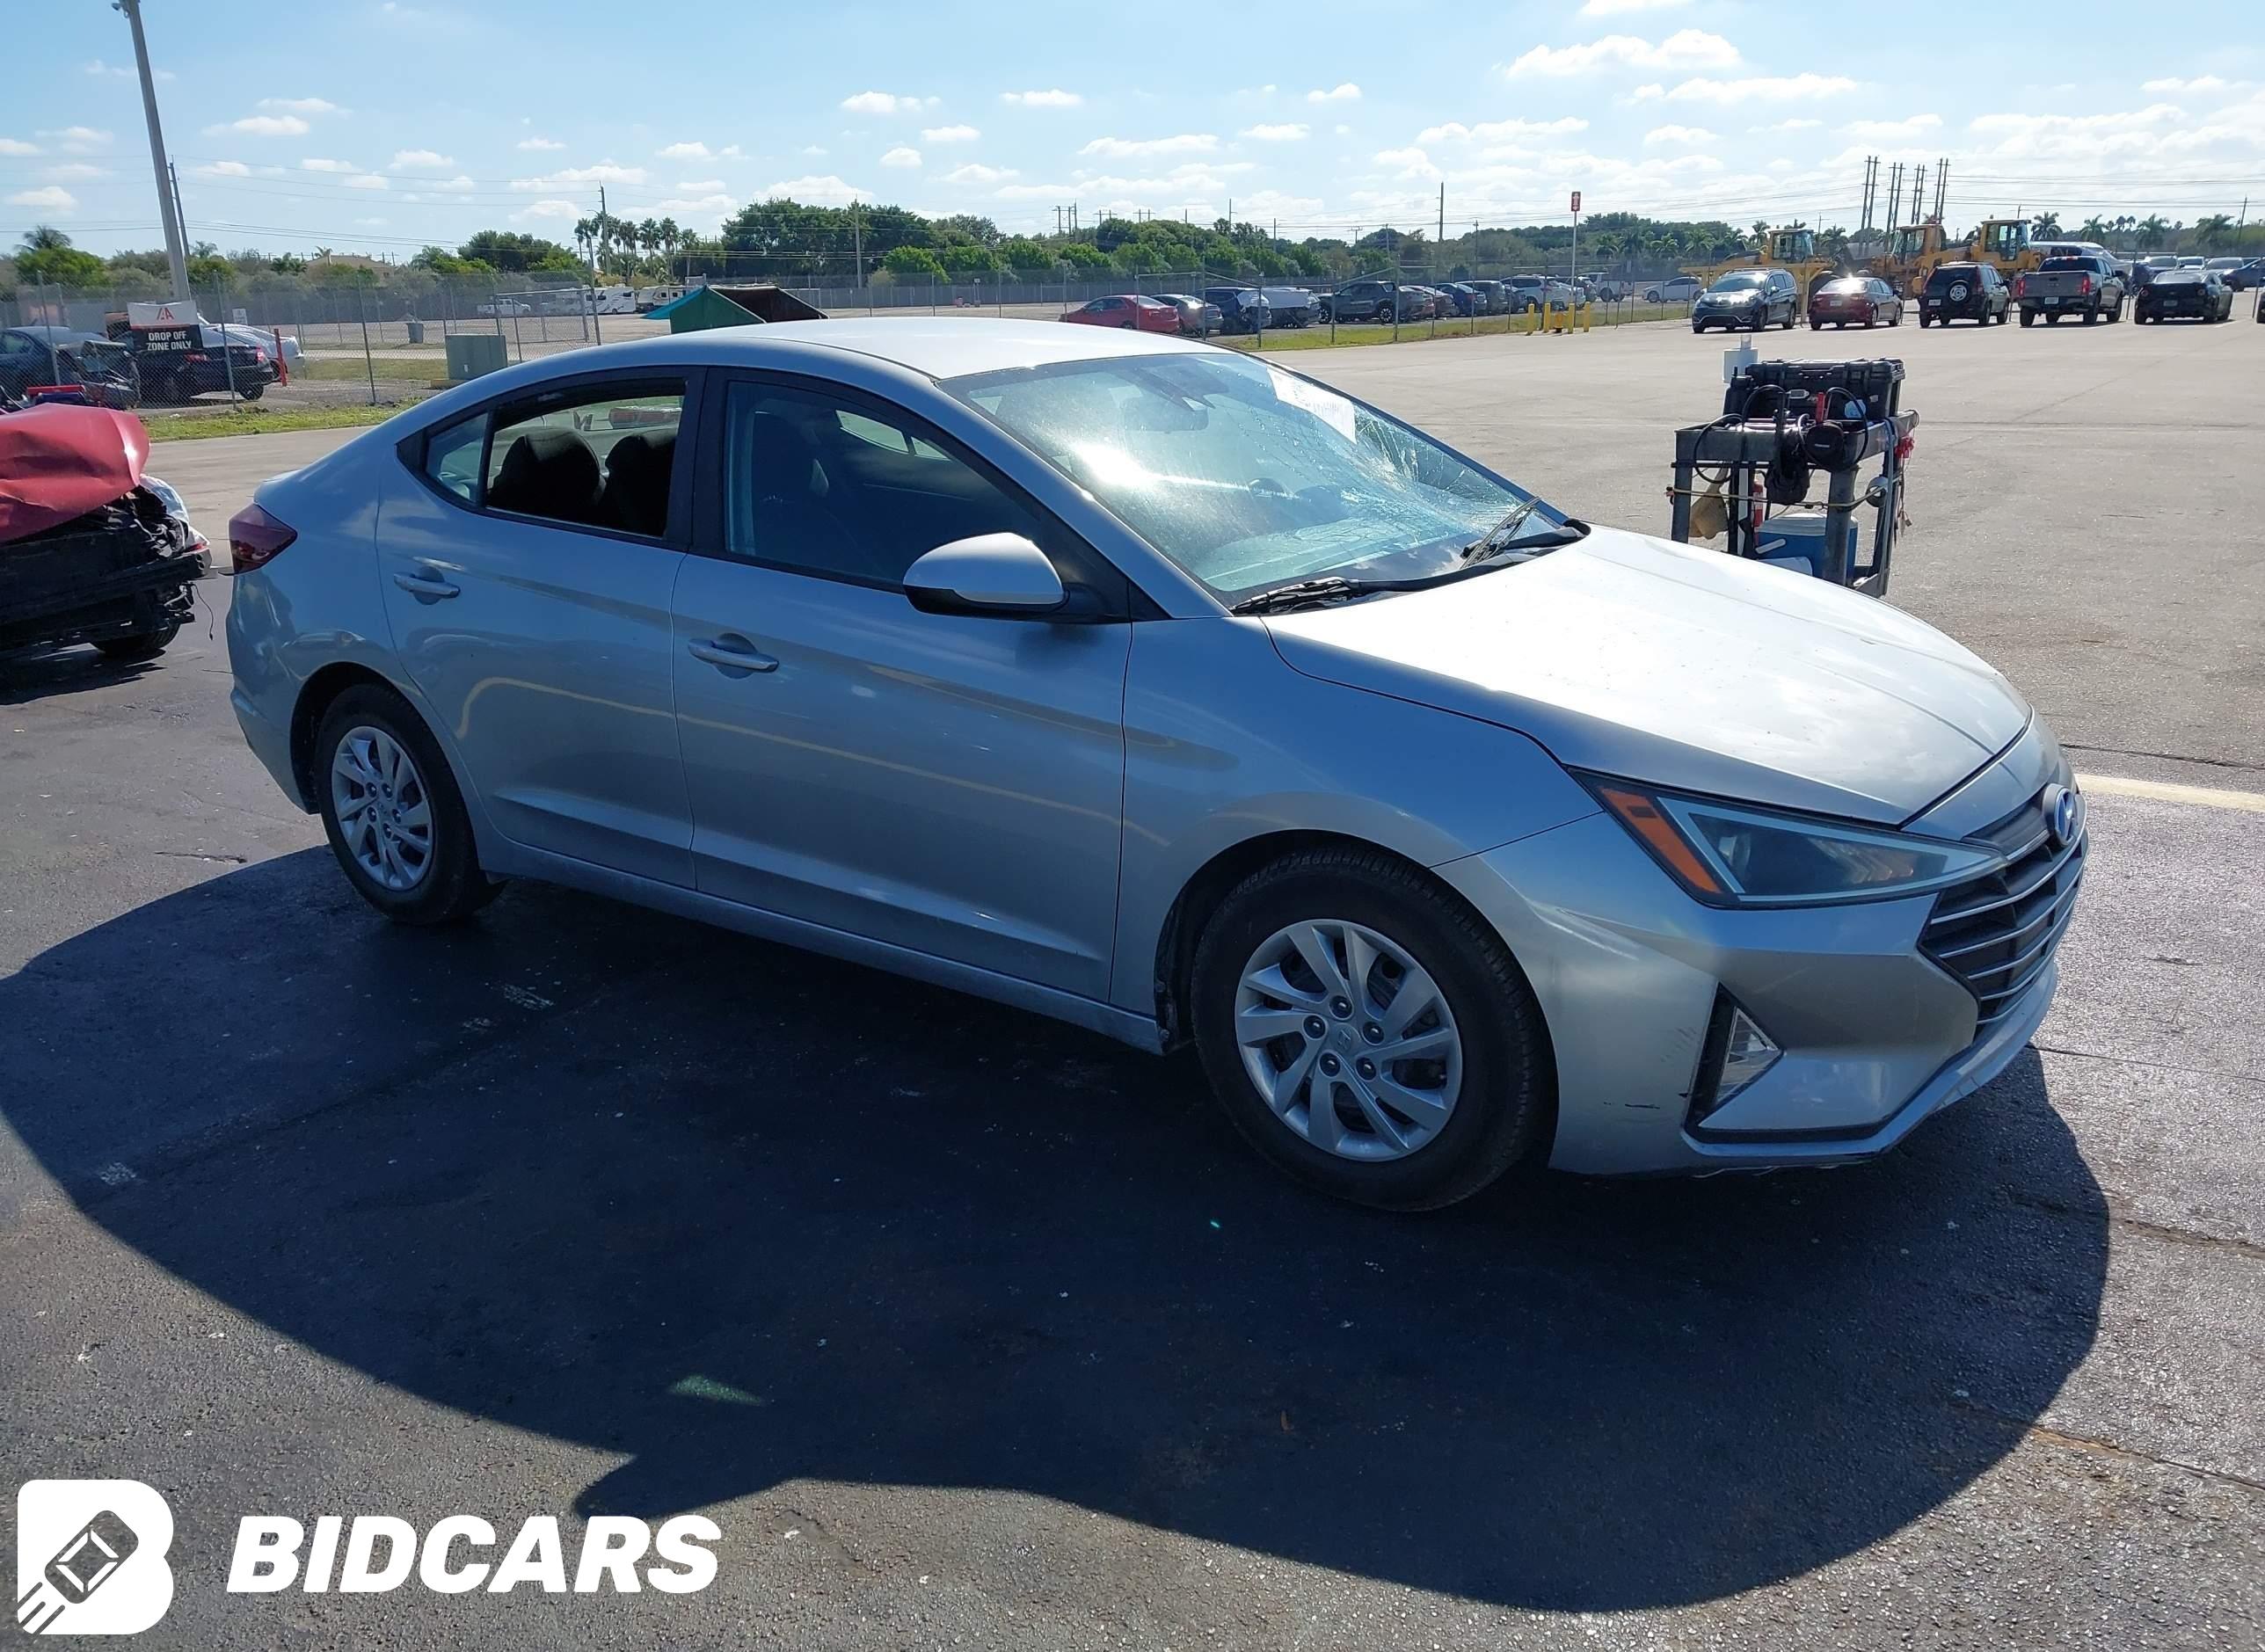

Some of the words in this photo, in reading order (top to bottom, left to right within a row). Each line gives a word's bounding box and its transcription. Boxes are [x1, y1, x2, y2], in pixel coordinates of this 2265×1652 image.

[148, 331, 171, 341] DROP
[173, 331, 187, 340] OFF
[146, 342, 170, 351] ZONE
[171, 340, 192, 350] ONLY
